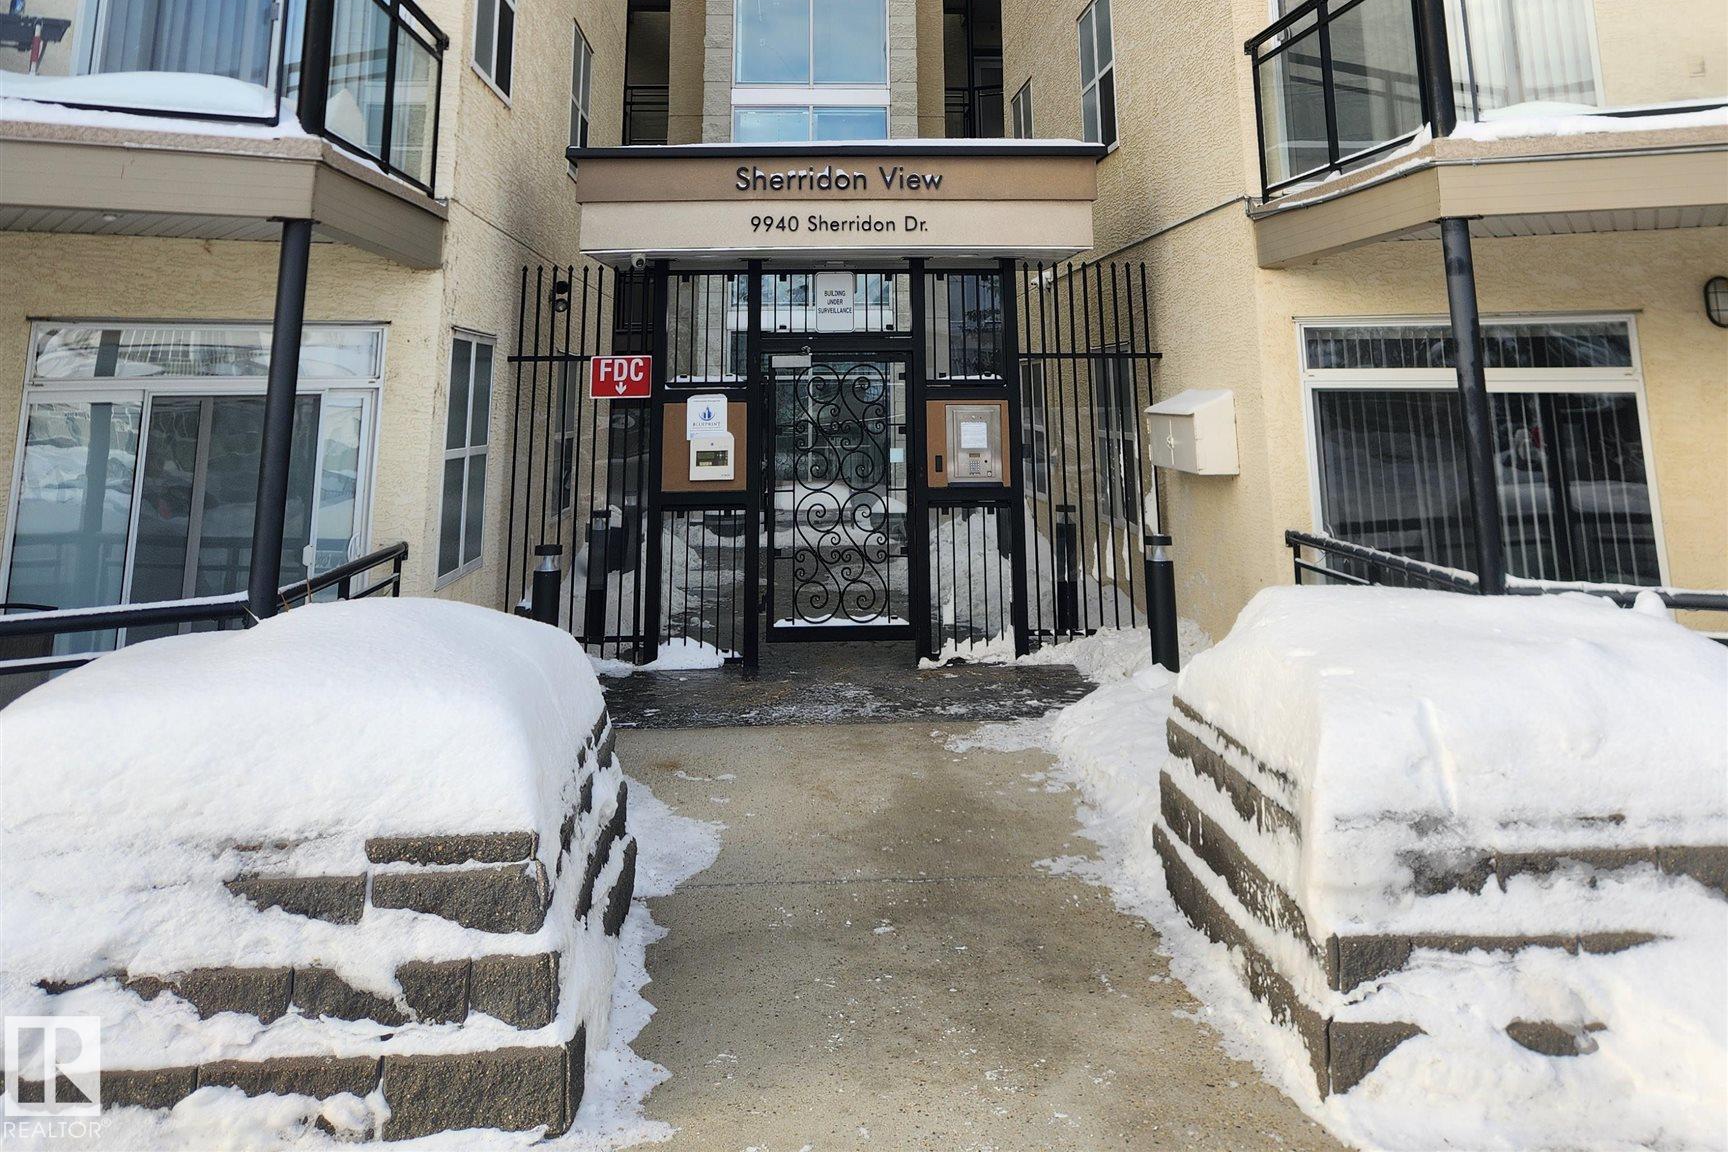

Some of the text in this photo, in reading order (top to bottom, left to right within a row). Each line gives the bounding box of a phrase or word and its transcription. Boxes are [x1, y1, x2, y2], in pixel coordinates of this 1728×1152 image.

[736, 165, 943, 191] Sherridon View
[750, 214, 928, 232] 9940 Sherridon Dr.
[824, 290, 846, 298] BUILDING
[818, 307, 852, 315] SURVEILLANCE
[599, 358, 644, 382] FDC
